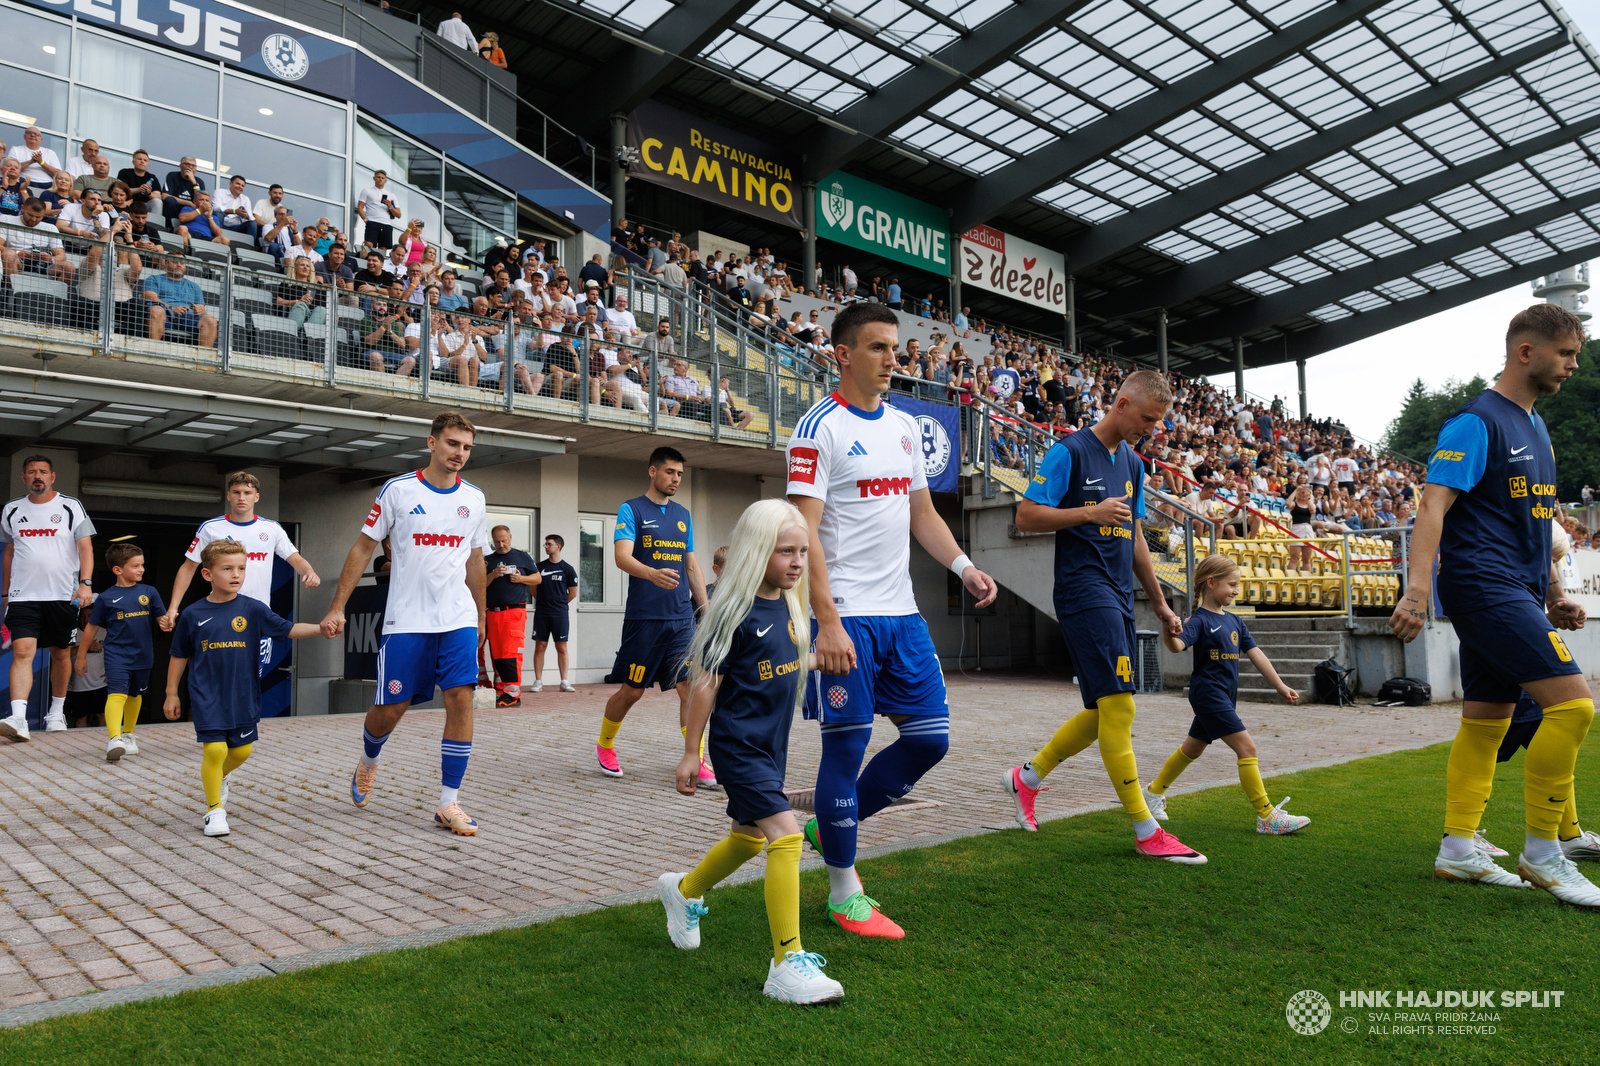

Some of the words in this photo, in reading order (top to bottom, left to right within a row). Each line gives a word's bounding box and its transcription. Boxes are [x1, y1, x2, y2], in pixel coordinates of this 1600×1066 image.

[641, 137, 793, 213] CAMINO
[857, 205, 946, 265] GRAWE
[928, 463, 943, 474] KLUB
[1511, 478, 1525, 491] CC
[19, 528, 58, 537] TOMMY
[412, 533, 465, 548] TOMMY
[246, 552, 268, 561] MMY
[661, 552, 683, 562] GRAWE
[348, 612, 382, 653] NK
[208, 641, 246, 649] CINKARNA
[1548, 631, 1572, 662] 6
[628, 663, 646, 683] 10
[760, 661, 771, 674] CC
[835, 797, 855, 807] 1911
